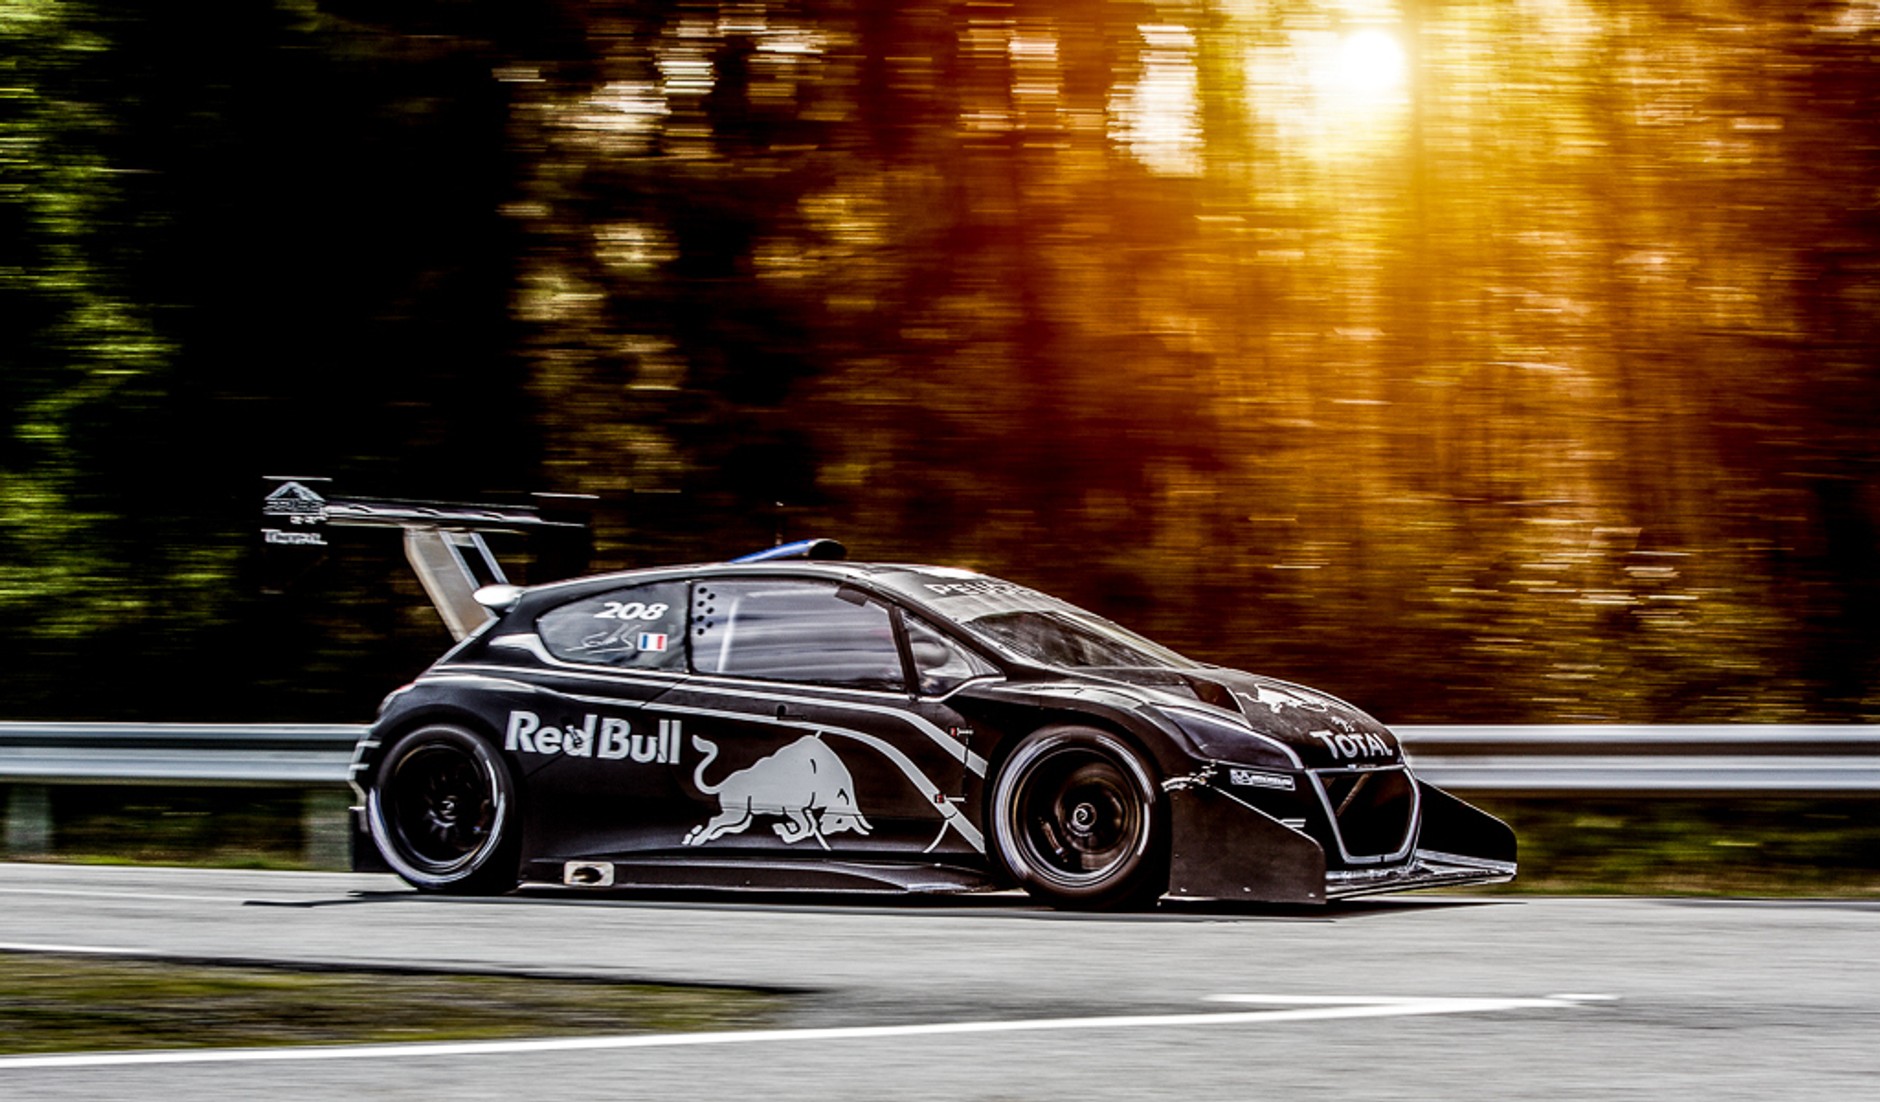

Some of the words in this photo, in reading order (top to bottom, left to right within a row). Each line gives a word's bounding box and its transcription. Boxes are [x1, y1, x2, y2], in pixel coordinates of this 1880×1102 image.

[594, 602, 669, 620] 208
[505, 710, 598, 758] Red
[597, 717, 682, 765] Bull
[1309, 729, 1393, 760] TOTAL
